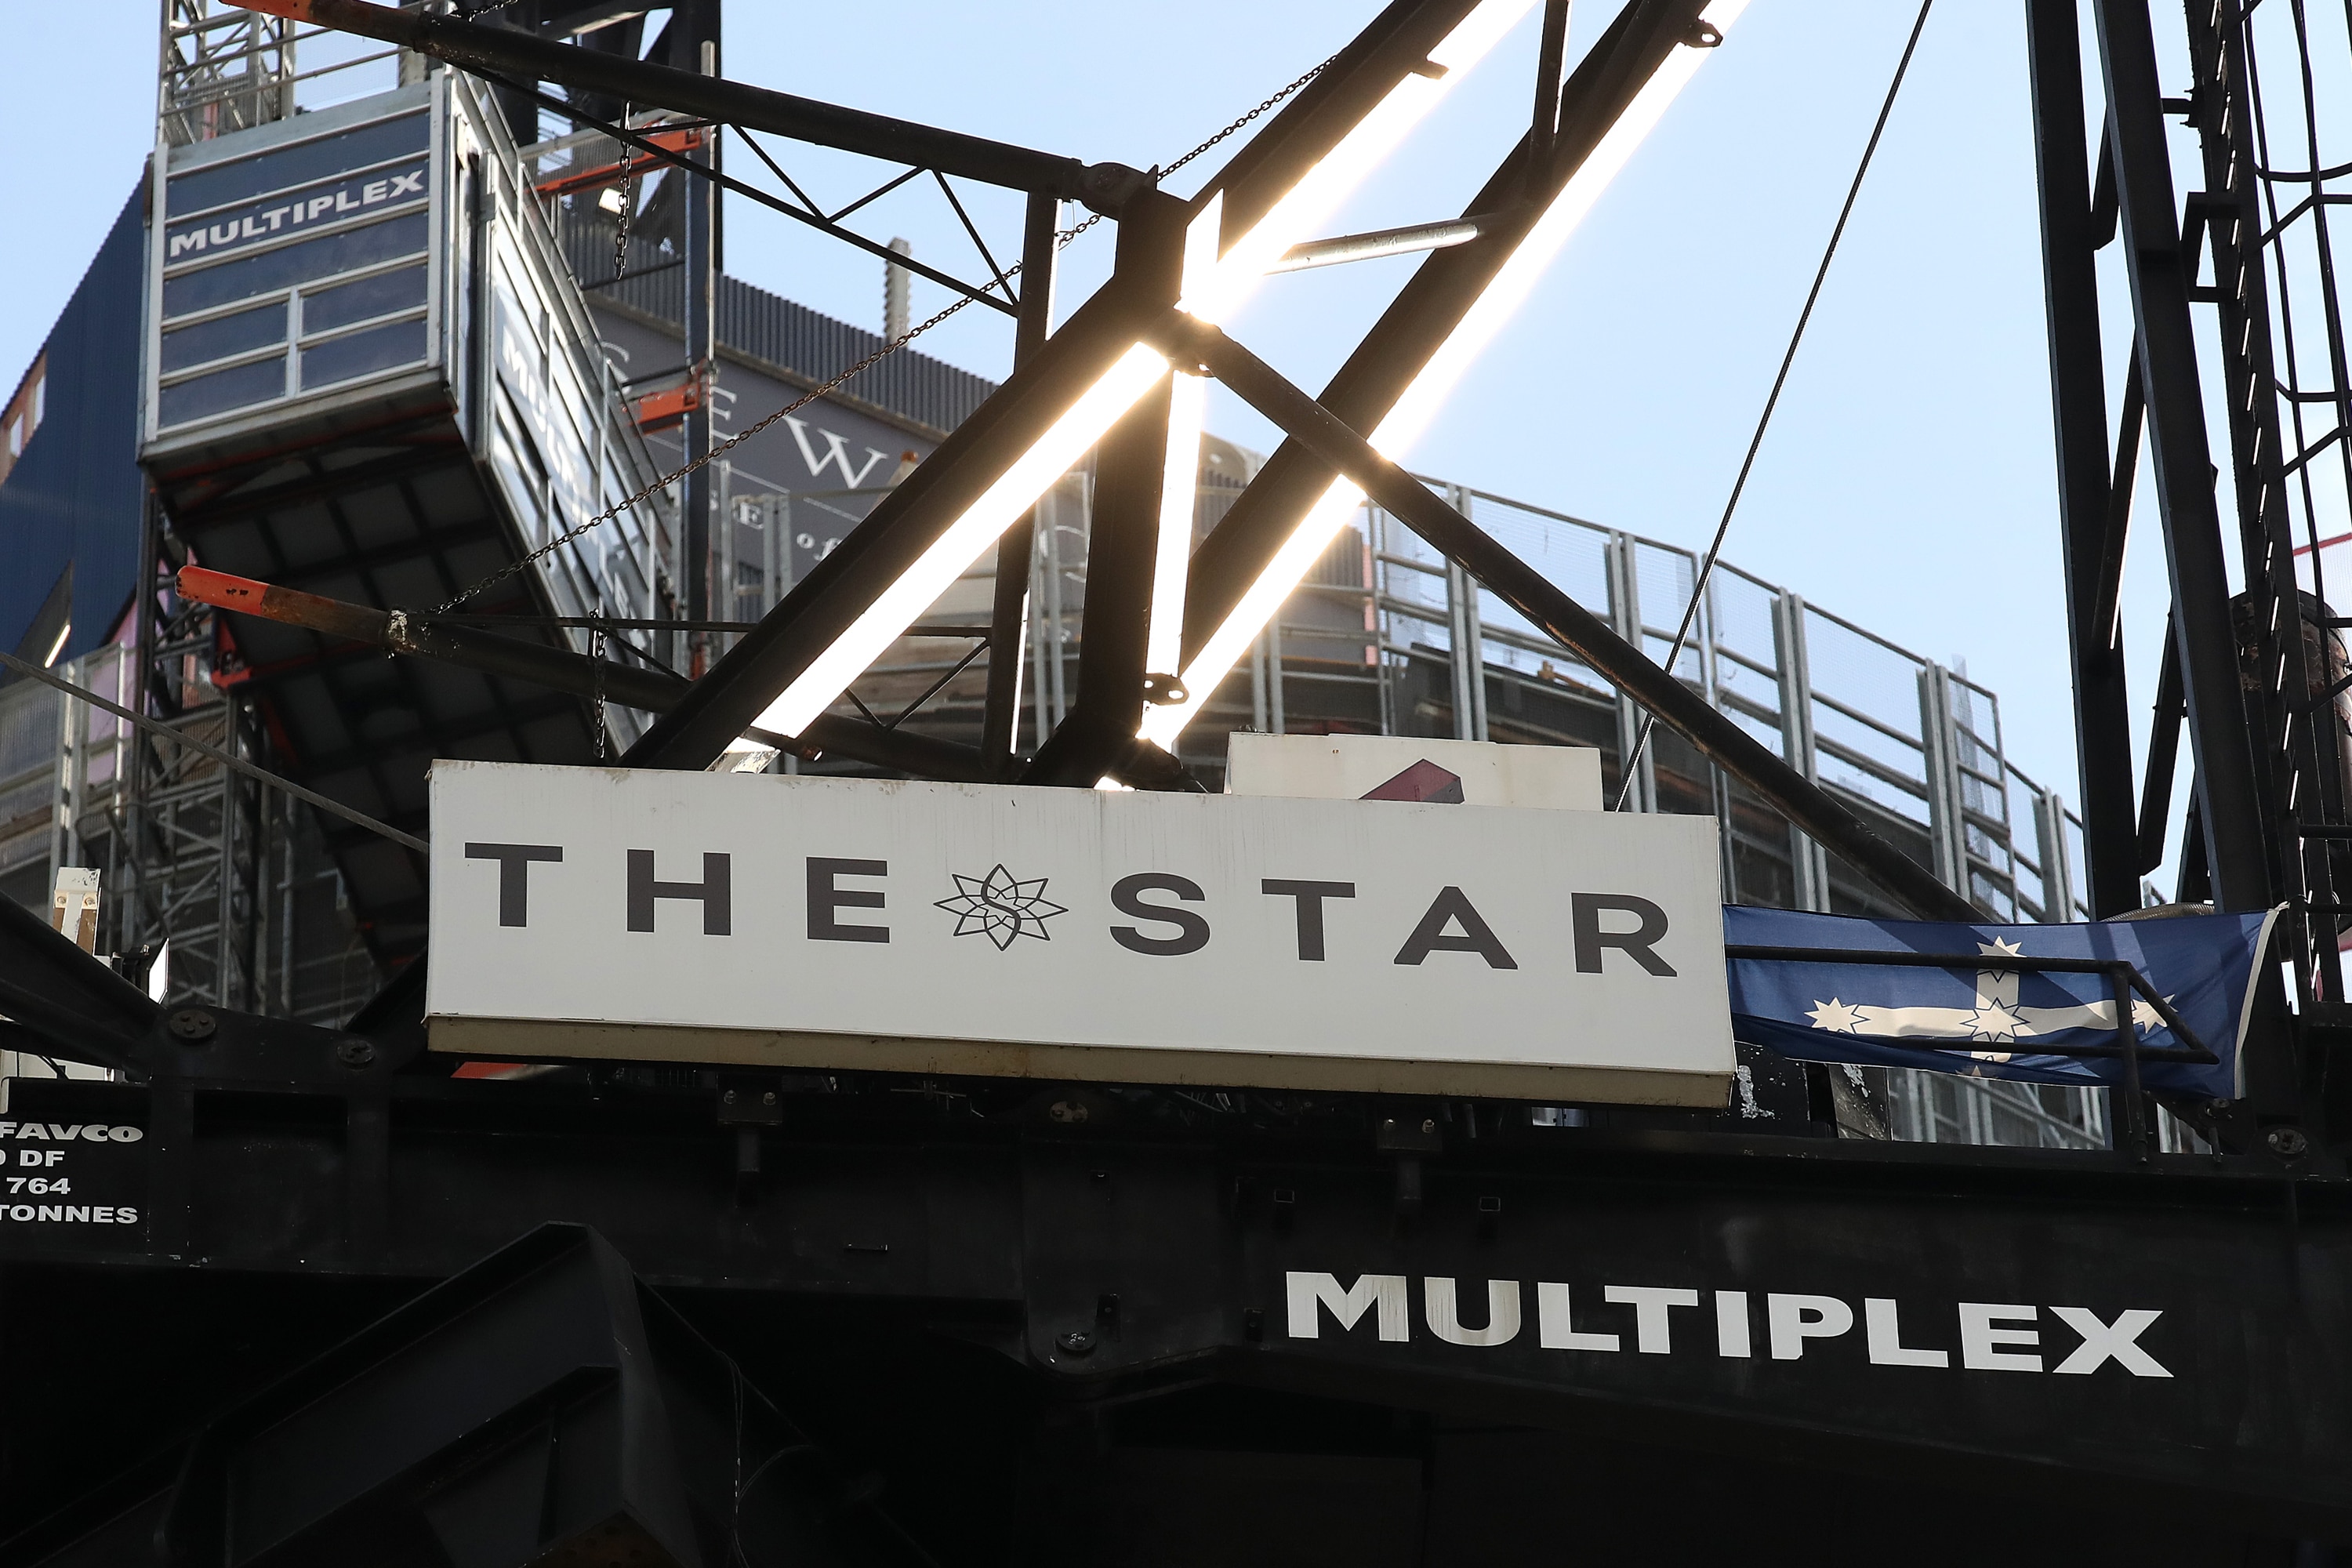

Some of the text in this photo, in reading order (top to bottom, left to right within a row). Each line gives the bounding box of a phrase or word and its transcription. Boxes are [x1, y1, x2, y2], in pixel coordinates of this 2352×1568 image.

[169, 169, 424, 257] MULTIPLEX
[464, 841, 1678, 978] THE STAR
[6, 1177, 71, 1195] 764
[20, 1149, 65, 1167] DF
[1285, 1270, 2175, 1378] MULTIPLEX
